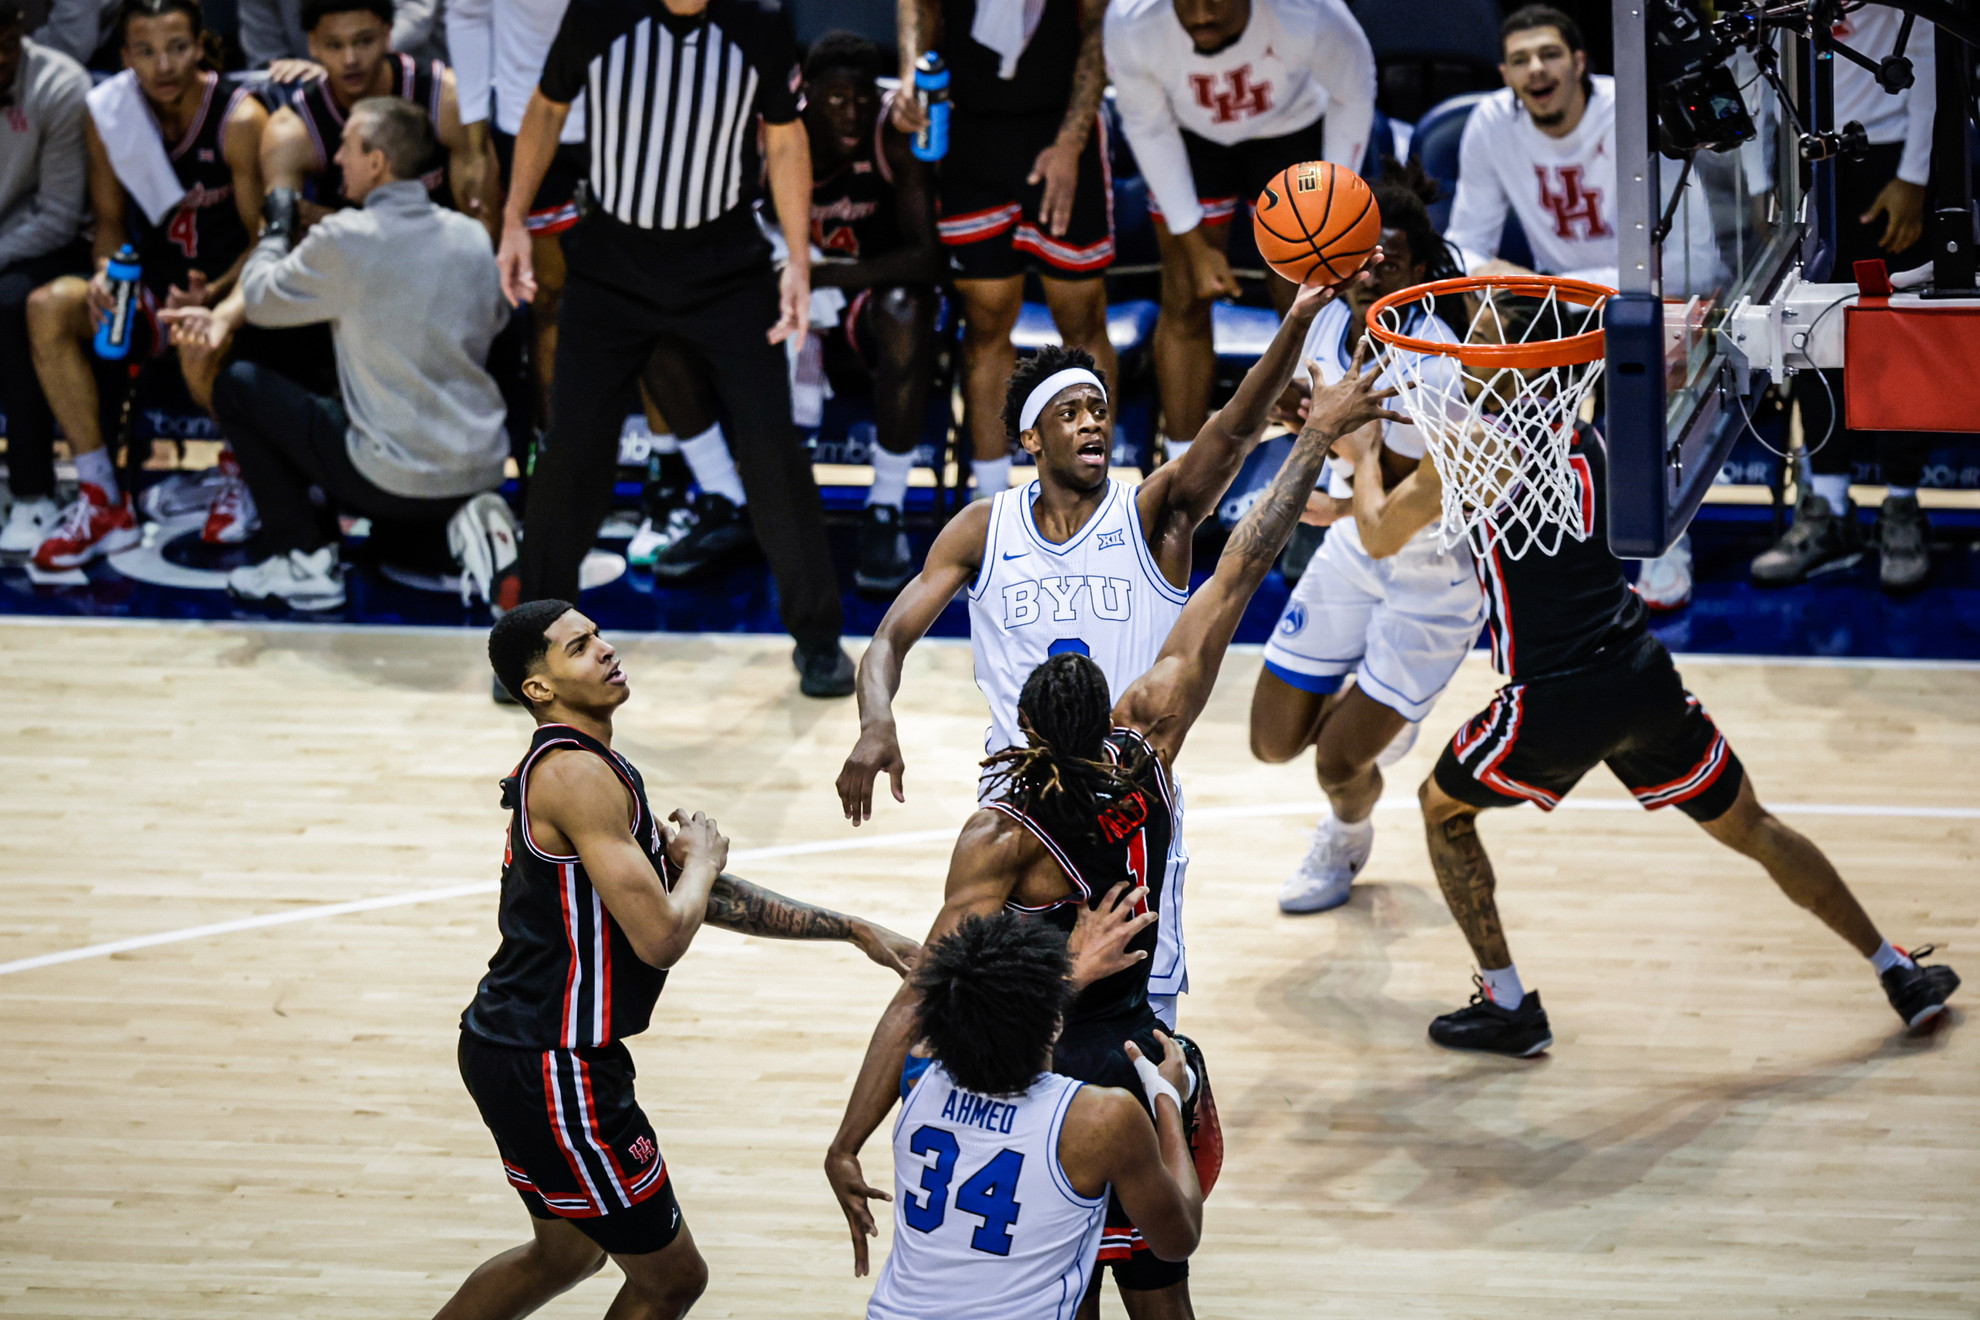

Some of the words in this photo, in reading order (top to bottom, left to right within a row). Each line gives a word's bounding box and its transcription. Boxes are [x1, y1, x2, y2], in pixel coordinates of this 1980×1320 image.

[1187, 61, 1274, 125] UH
[1533, 162, 1614, 242] UH
[168, 205, 198, 258] 4
[1002, 575, 1131, 629] BYU
[941, 1089, 1018, 1134] AHMED
[628, 1135, 656, 1165] UH
[904, 1124, 1025, 1256] 34
